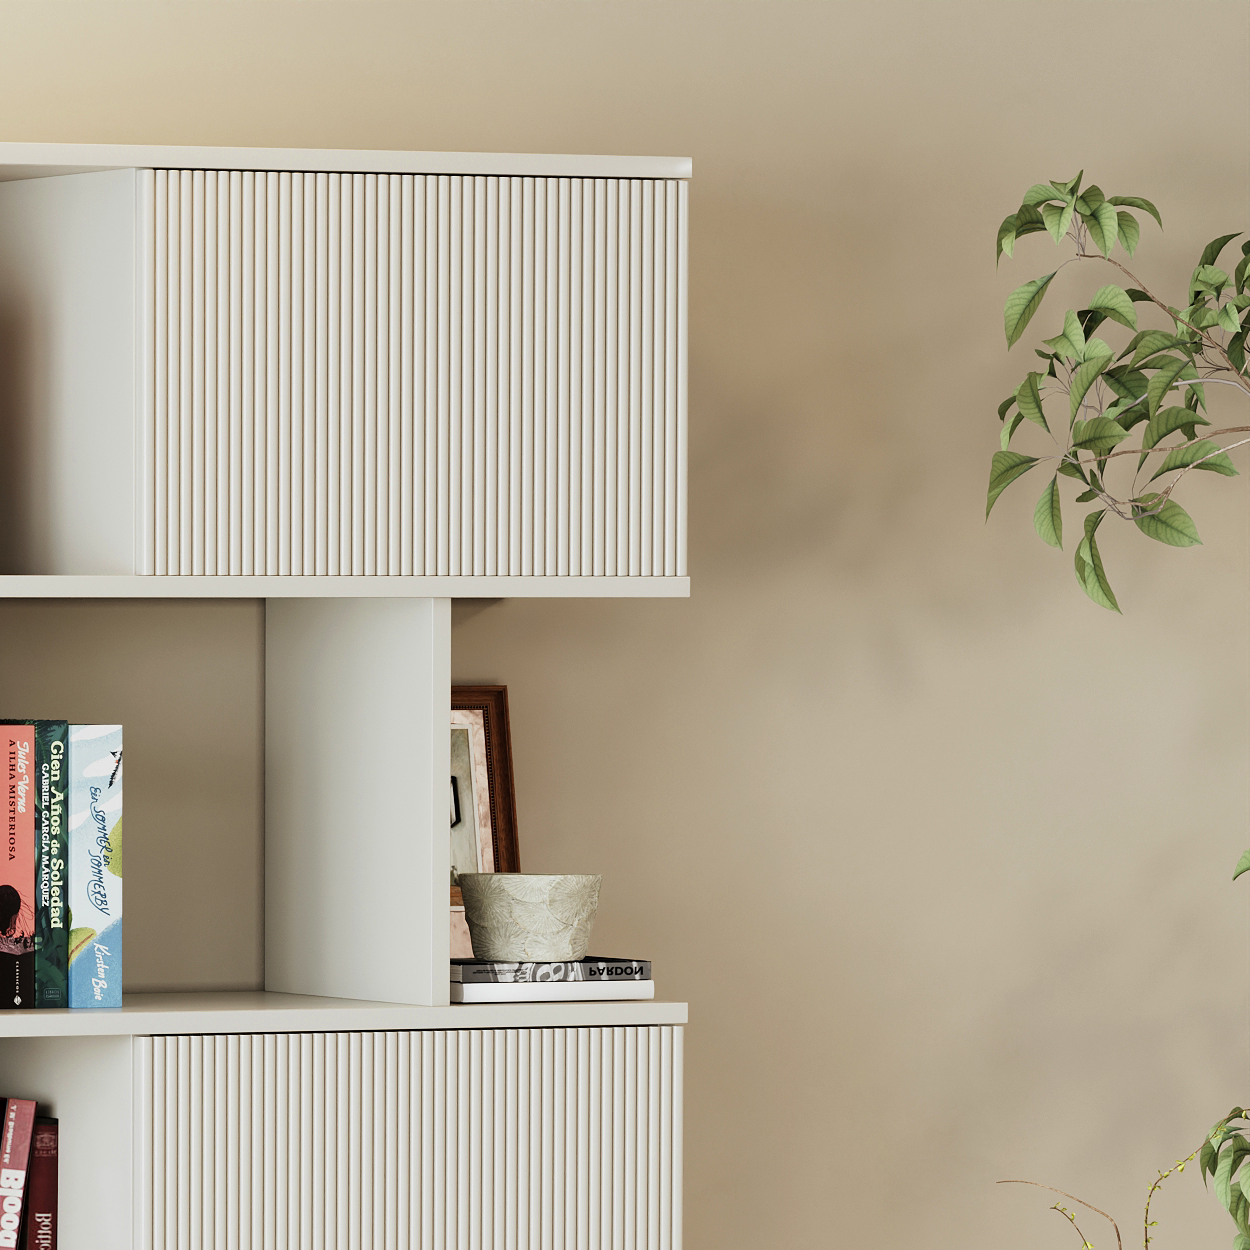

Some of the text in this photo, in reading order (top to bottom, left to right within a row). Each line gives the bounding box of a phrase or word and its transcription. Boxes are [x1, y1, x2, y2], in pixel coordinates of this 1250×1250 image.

[9, 739, 16, 747] A
[16, 740, 30, 814] Jules Verne
[40, 763, 50, 907] GABRIEL GARCÍA MÁRQUEZ
[50, 740, 65, 928] Cien Años de Soledad
[93, 942, 112, 979] Kirsten
